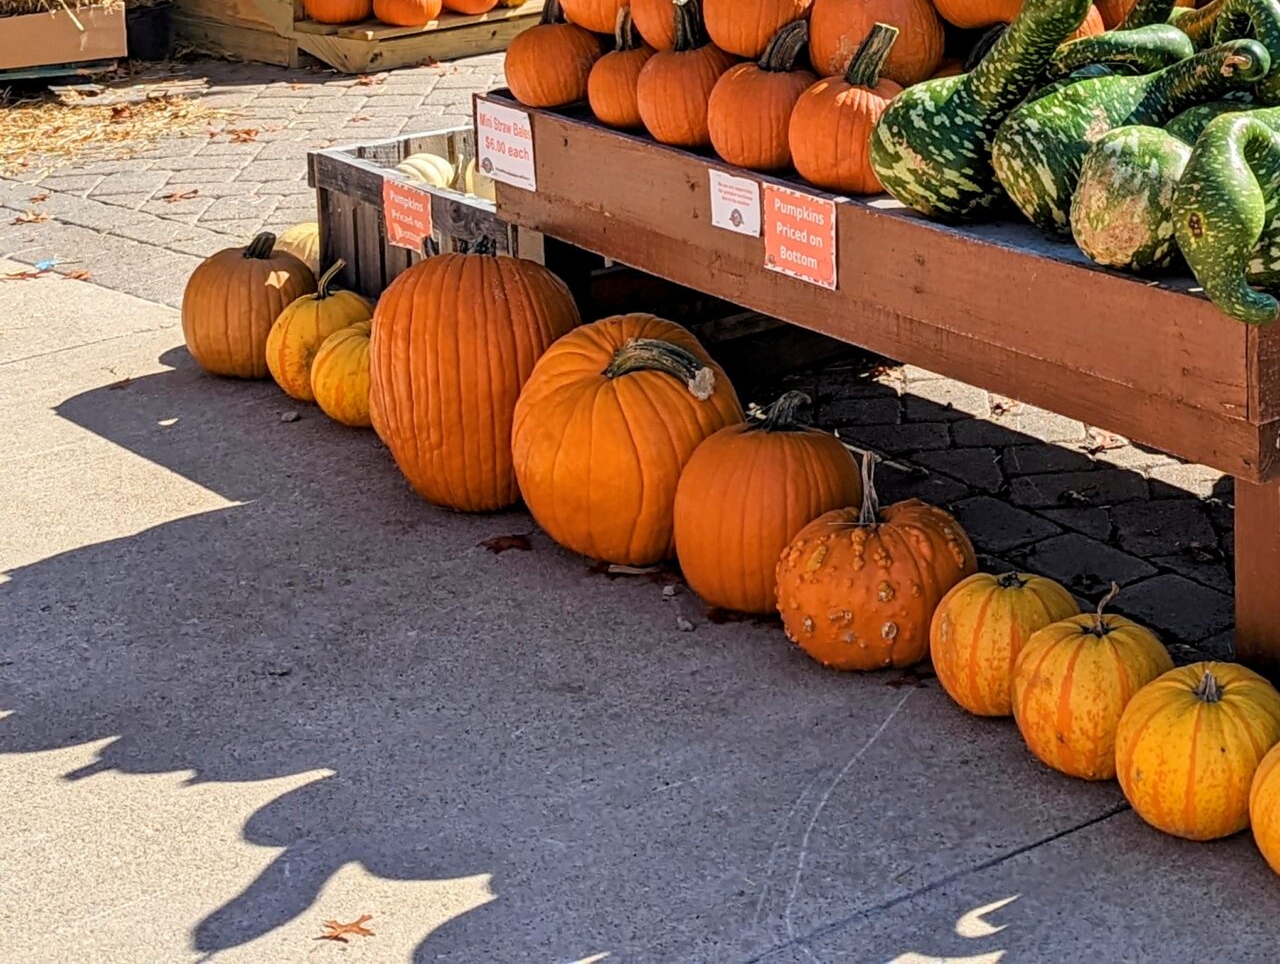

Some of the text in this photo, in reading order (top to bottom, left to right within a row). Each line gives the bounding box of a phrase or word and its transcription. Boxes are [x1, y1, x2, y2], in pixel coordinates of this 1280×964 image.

[480, 113, 531, 141] Mini Straw Bales
[485, 135, 530, 161] $6.00 each
[774, 198, 825, 226] Pumpkins
[776, 221, 823, 248] Priced on
[780, 245, 818, 269] Bottom
